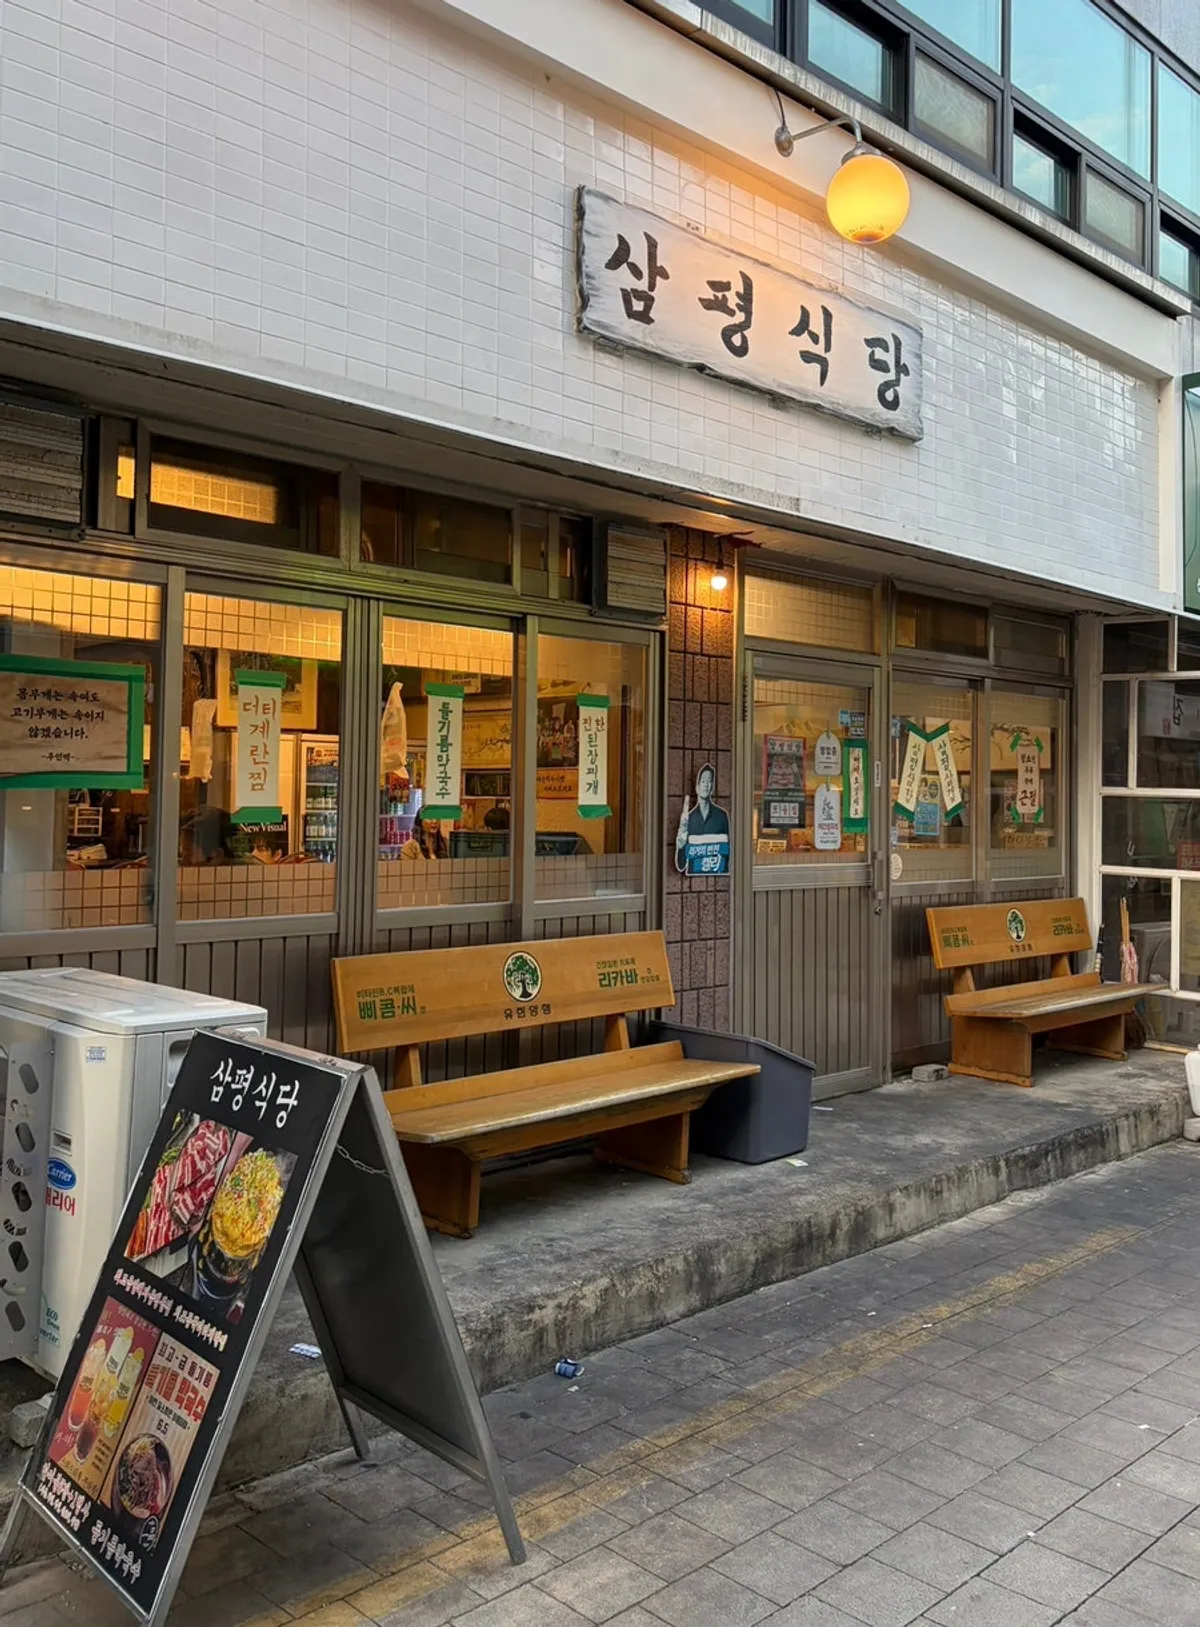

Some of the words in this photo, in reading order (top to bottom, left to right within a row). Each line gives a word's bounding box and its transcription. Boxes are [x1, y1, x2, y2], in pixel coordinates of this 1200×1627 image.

[604, 231, 910, 411] 삼평식당
[28, 726, 89, 740] 않겠습니다.
[598, 968, 638, 989] 리카바
[210, 1057, 300, 1129] 삼평식당
